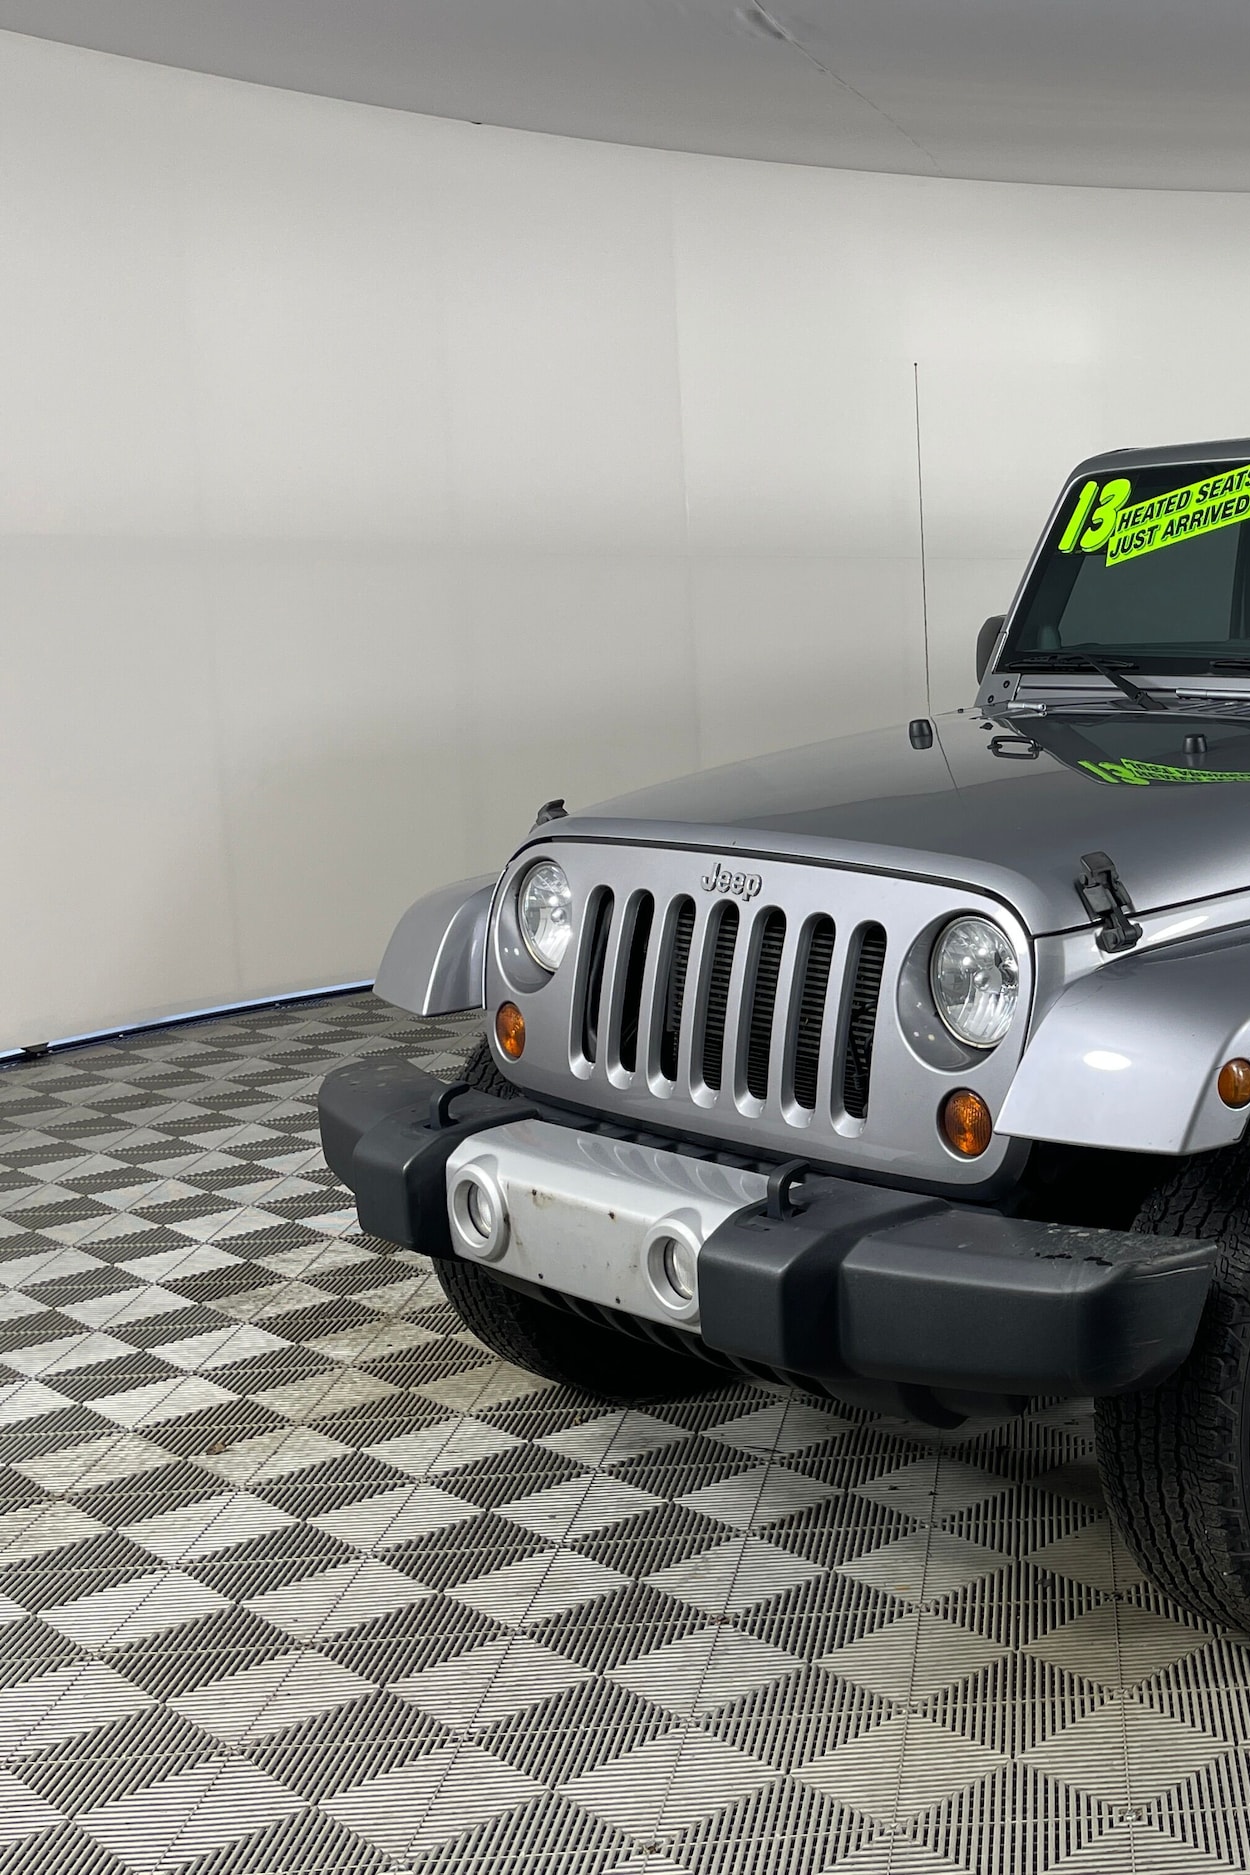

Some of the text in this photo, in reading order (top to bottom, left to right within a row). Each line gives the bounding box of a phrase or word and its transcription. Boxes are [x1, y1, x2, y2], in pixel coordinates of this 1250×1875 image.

[1058, 478, 1132, 553] 13
[1117, 489, 1193, 533] HEATED
[1109, 523, 1160, 558] JUST
[701, 863, 763, 902] Jeep
